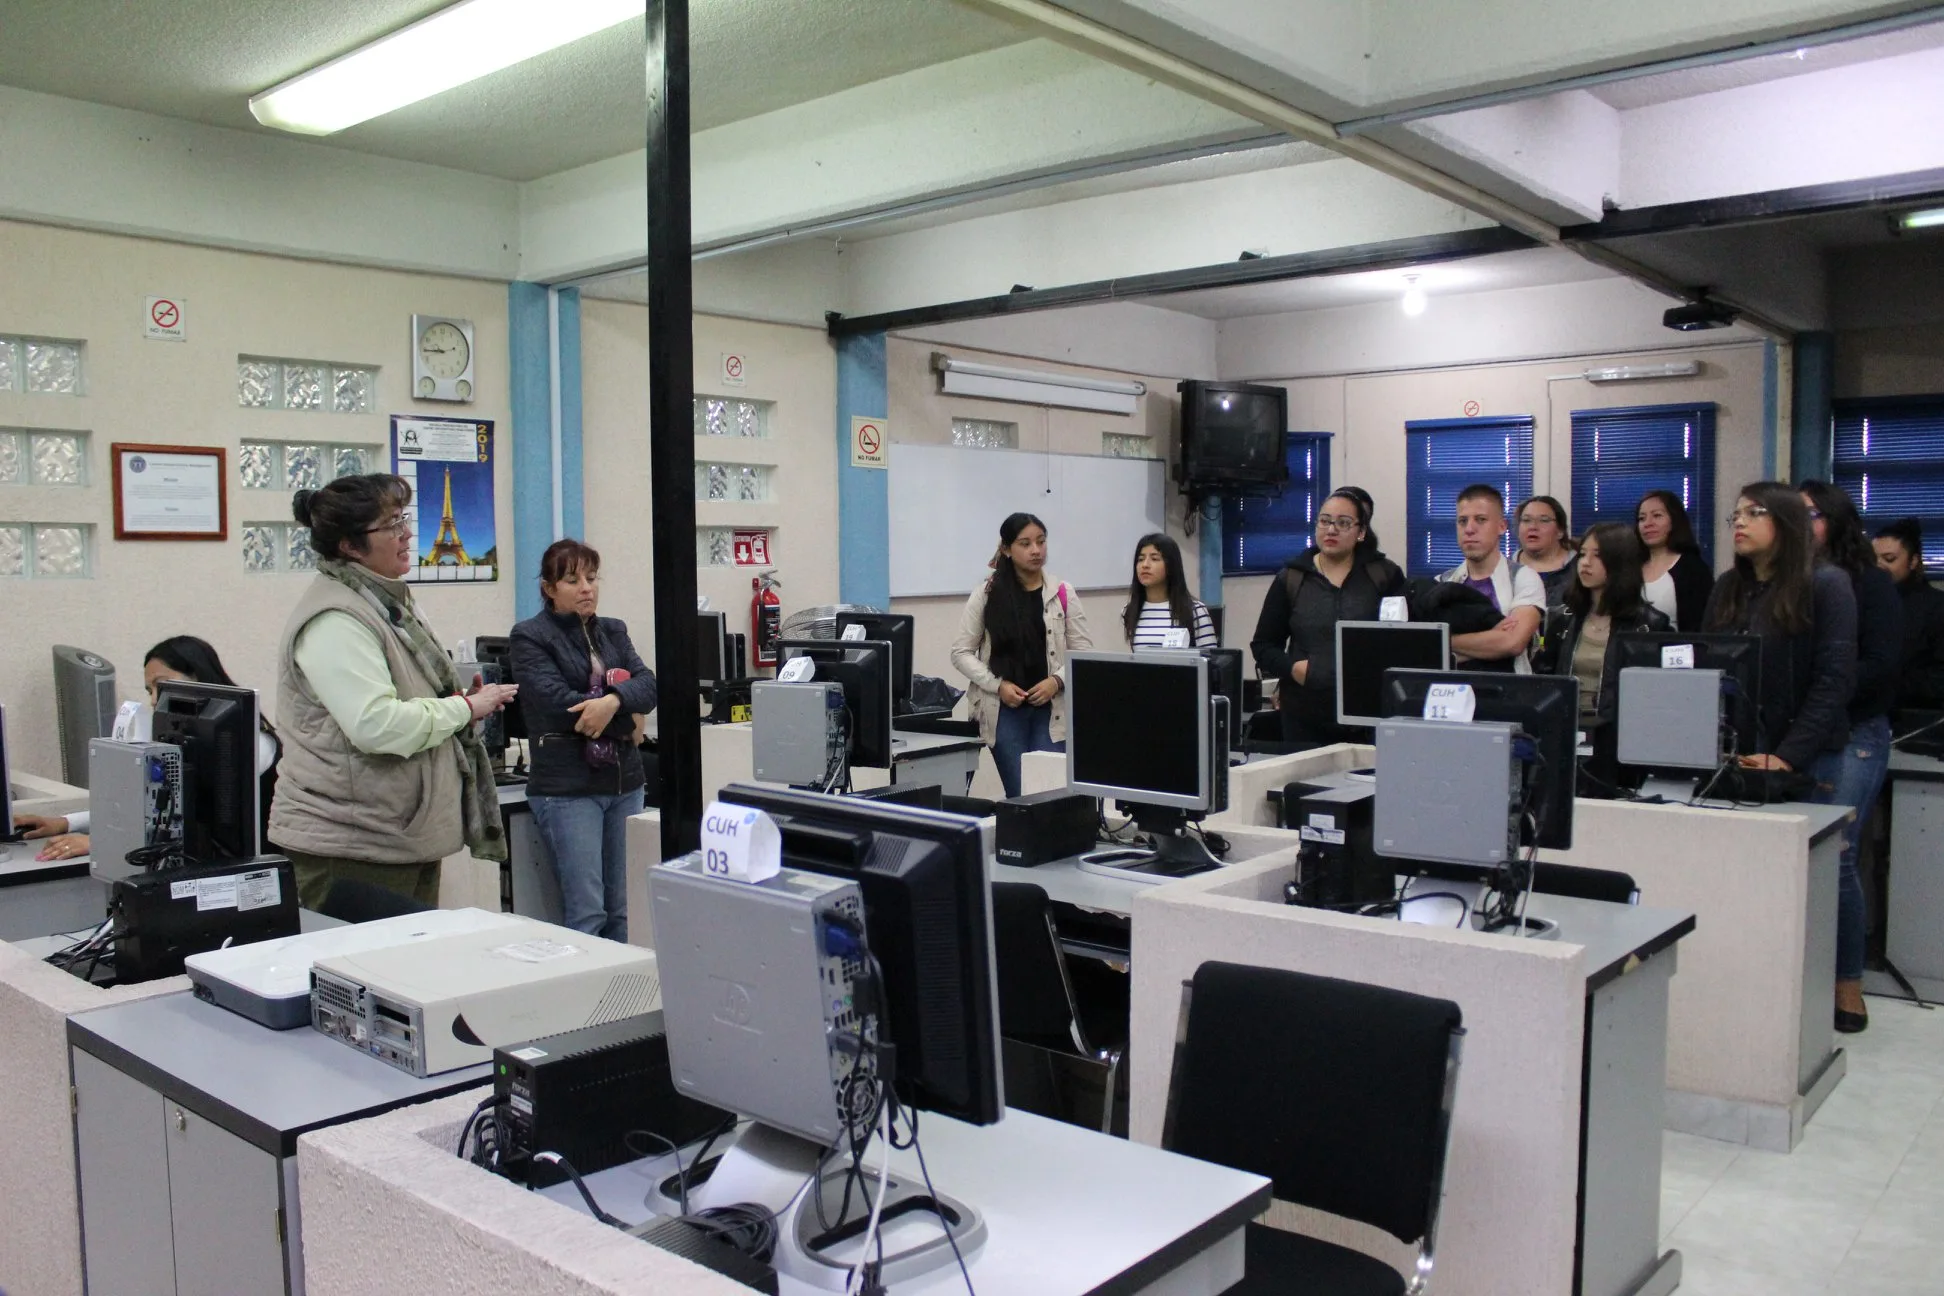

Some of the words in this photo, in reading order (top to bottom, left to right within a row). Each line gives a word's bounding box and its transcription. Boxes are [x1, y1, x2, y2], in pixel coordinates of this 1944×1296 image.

[477, 424, 488, 462] 2019
[1669, 656, 1684, 666] 16
[782, 671, 795, 680] 09
[1431, 688, 1455, 697] CUH
[1431, 705, 1448, 719] 11
[707, 815, 739, 836] CUH
[1000, 848, 1022, 858] forza
[707, 848, 728, 874] 03
